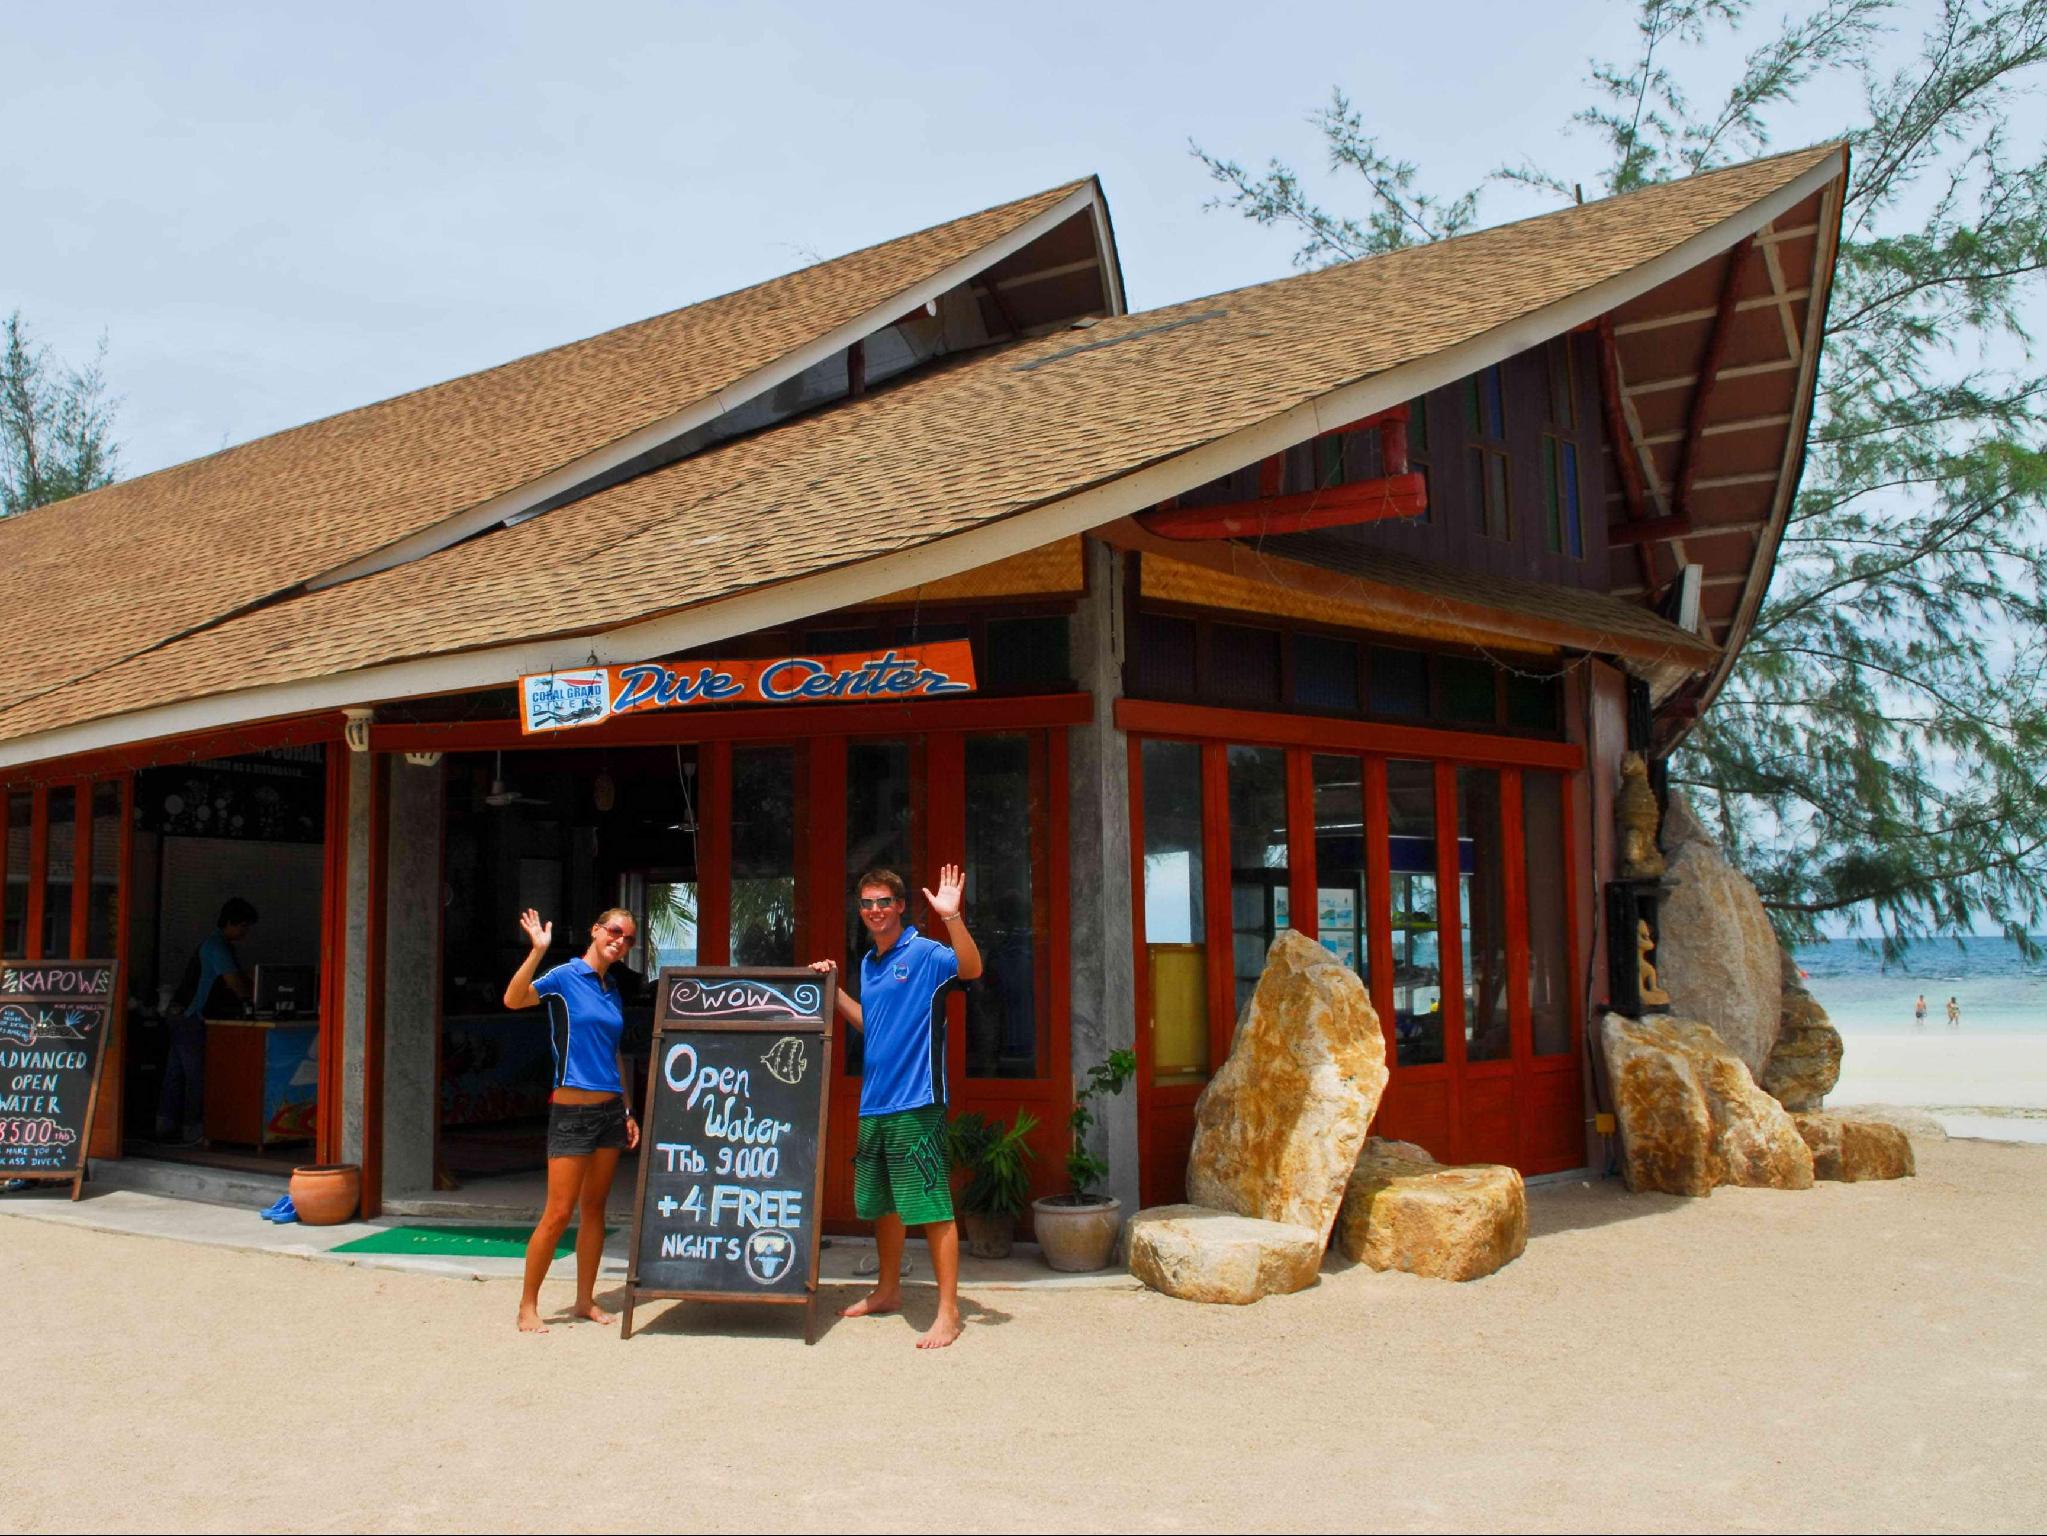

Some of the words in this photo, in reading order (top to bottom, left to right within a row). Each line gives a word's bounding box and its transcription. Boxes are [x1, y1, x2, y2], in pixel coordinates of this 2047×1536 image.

[612, 664, 744, 713] Dive
[758, 651, 971, 700] Center
[533, 690, 564, 702] CORAL
[567, 686, 602, 699] GRAND
[533, 698, 602, 712] DIVERS
[18, 969, 101, 993] KAPOW
[702, 988, 770, 1009] WOW
[11, 1074, 59, 1092] OPEN
[664, 1043, 750, 1111] Open
[0, 1094, 61, 1114] WATER
[703, 1094, 791, 1144] Water
[6, 1147, 29, 1156] MAKE
[9, 1158, 25, 1166] ASS
[656, 1143, 708, 1172] Thb.
[710, 1185, 802, 1229] FREE
[661, 1233, 741, 1261] NIGHT'S
